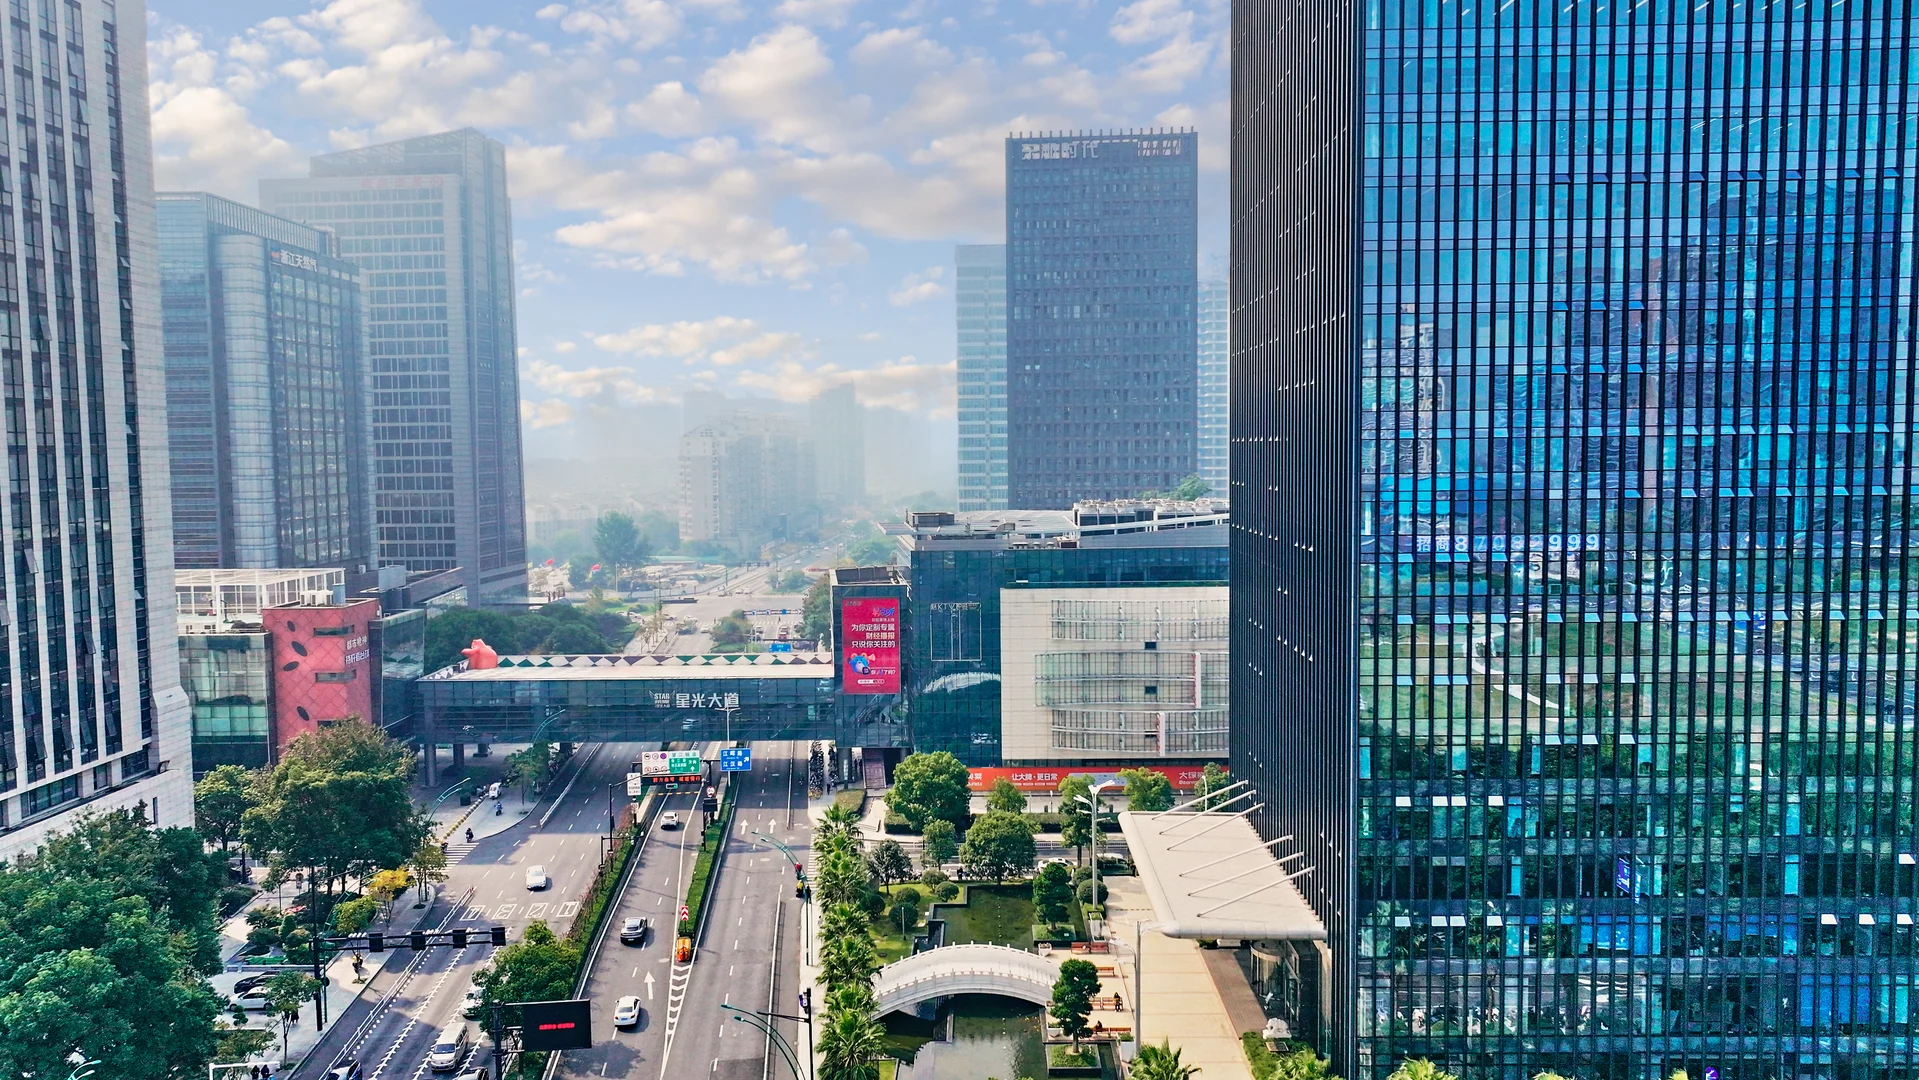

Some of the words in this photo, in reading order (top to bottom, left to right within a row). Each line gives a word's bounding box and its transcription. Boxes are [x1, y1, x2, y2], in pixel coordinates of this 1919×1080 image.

[280, 249, 318, 272] 浙江天然气
[851, 623, 895, 632] 为你定制专属
[865, 632, 895, 640] 财经播报
[851, 640, 896, 648] 只说你关注的
[654, 692, 670, 700] STAR
[676, 692, 740, 708] 星光大道
